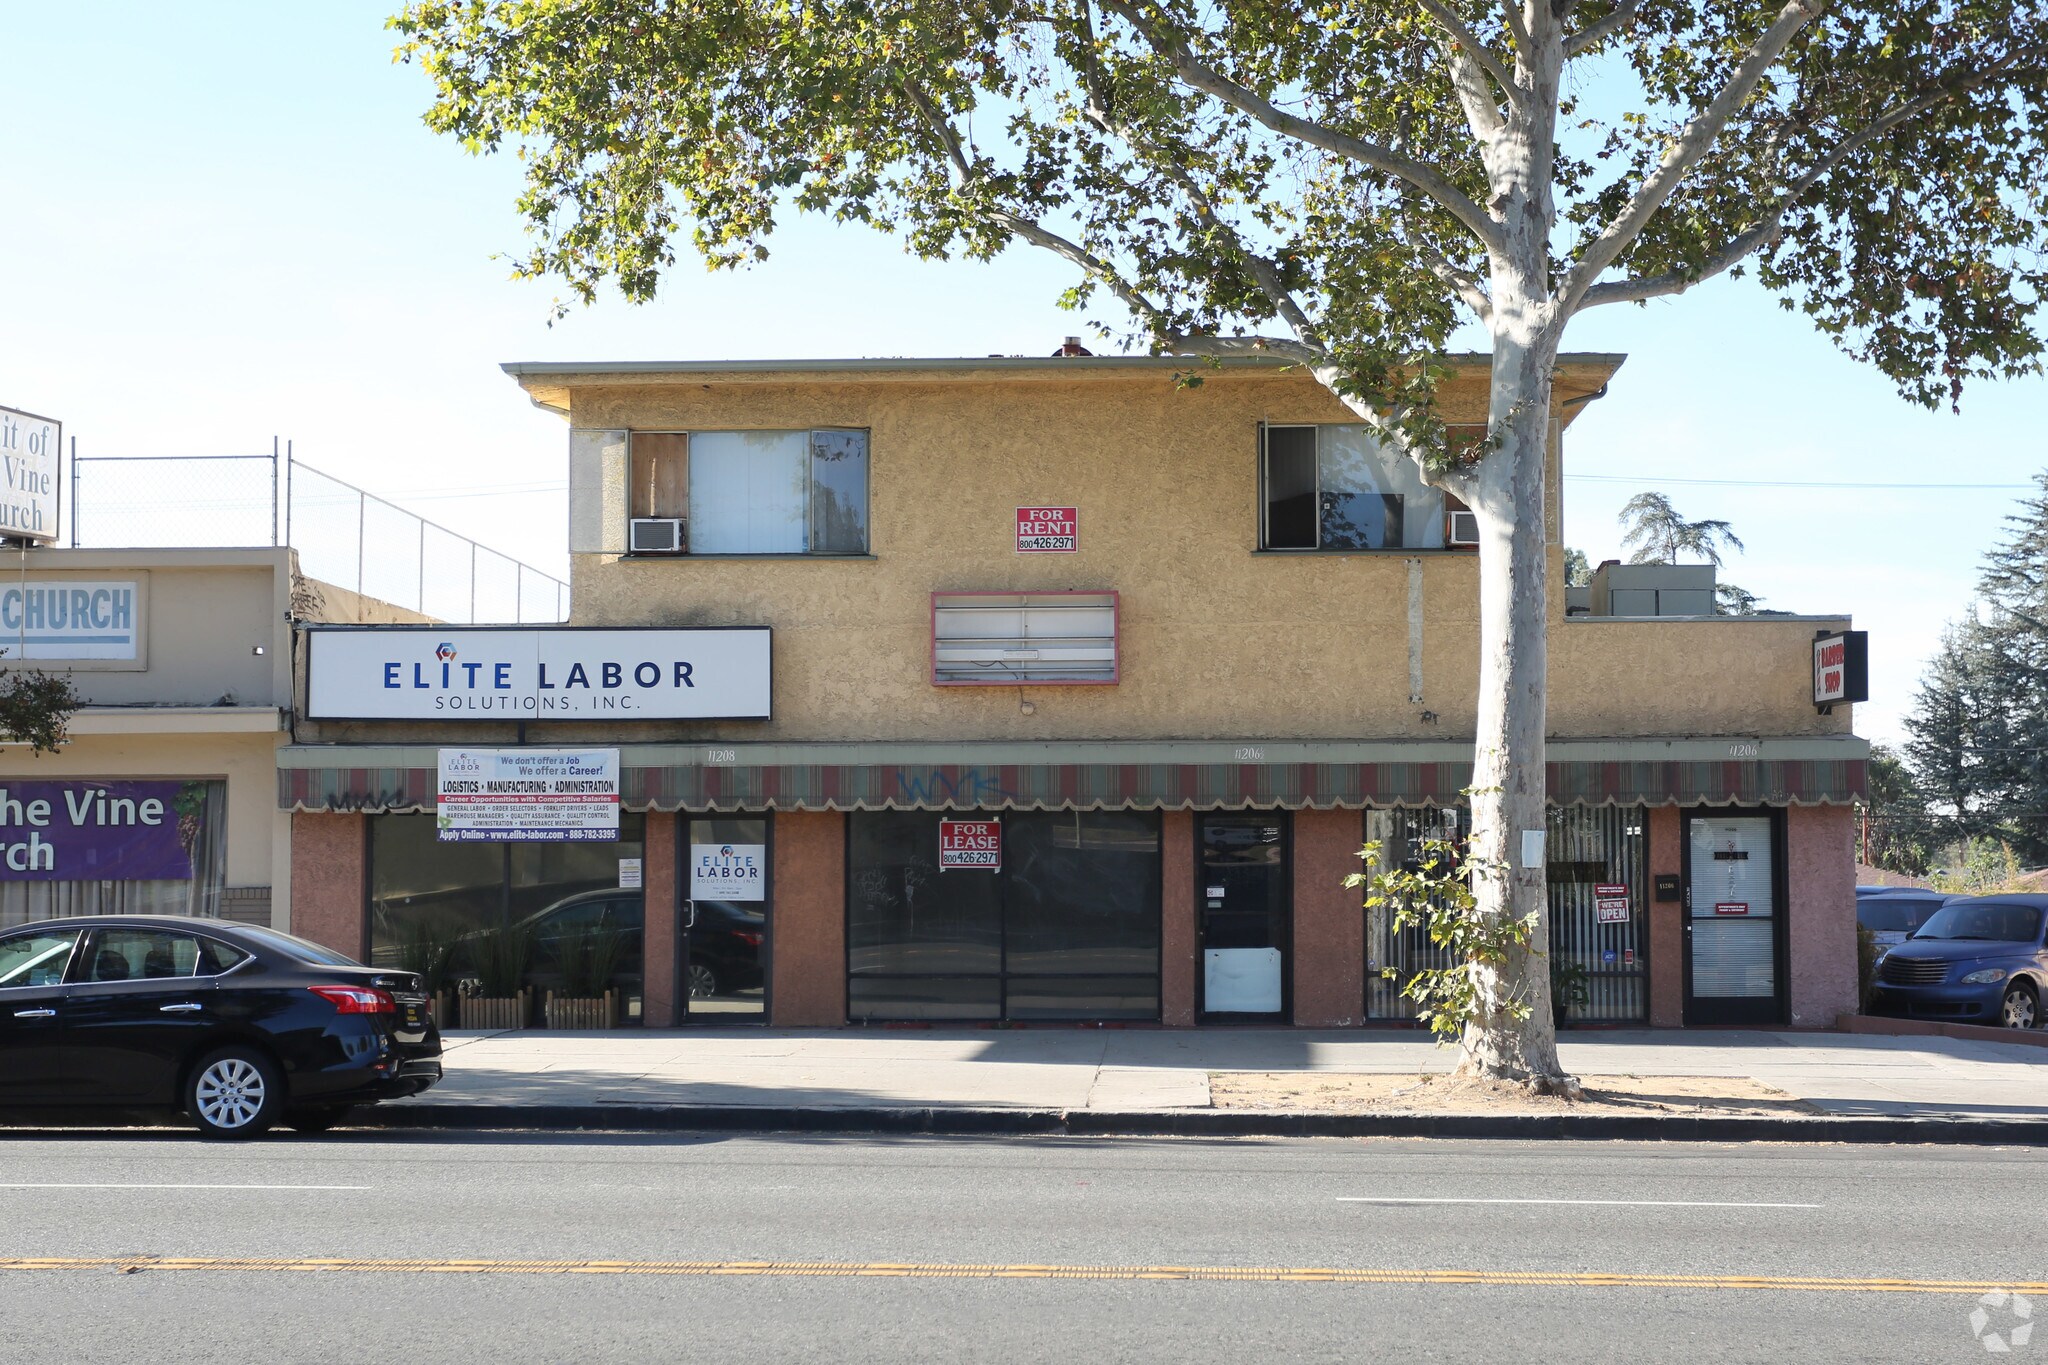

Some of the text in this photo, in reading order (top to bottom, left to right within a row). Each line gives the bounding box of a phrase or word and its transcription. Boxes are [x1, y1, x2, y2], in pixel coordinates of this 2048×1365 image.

[29, 425, 50, 457] of
[4, 455, 50, 495] Vine
[1030, 510, 1064, 520] FOR
[1019, 522, 1074, 534] RENT
[1020, 540, 1033, 548] 800
[2, 589, 131, 630] CHURCH
[384, 661, 696, 689] ELITE LABOR
[435, 696, 641, 712] SOLUTIONS, INC.
[708, 750, 735, 762] 11208
[1729, 744, 1757, 757] 11206
[501, 757, 513, 765] We
[515, 757, 536, 765] don't
[537, 757, 557, 765] offer
[566, 757, 580, 765] Job
[519, 767, 533, 775] We
[535, 766, 559, 775] offer
[569, 766, 603, 775] Career!
[443, 781, 614, 793] LOGISTICS MANUFACTURING ADMINISTRATION
[0, 789, 164, 826] he Vine
[440, 830, 616, 840] Apply Online www.elite-labor.com 888-782-3395
[954, 825, 988, 835] FOR
[943, 836, 998, 849] LEASE
[0, 832, 54, 871] ch
[703, 856, 753, 867] ELITE
[944, 855, 957, 863] 800
[697, 867, 758, 878] LABOR
[1600, 908, 1626, 920] OPEN
